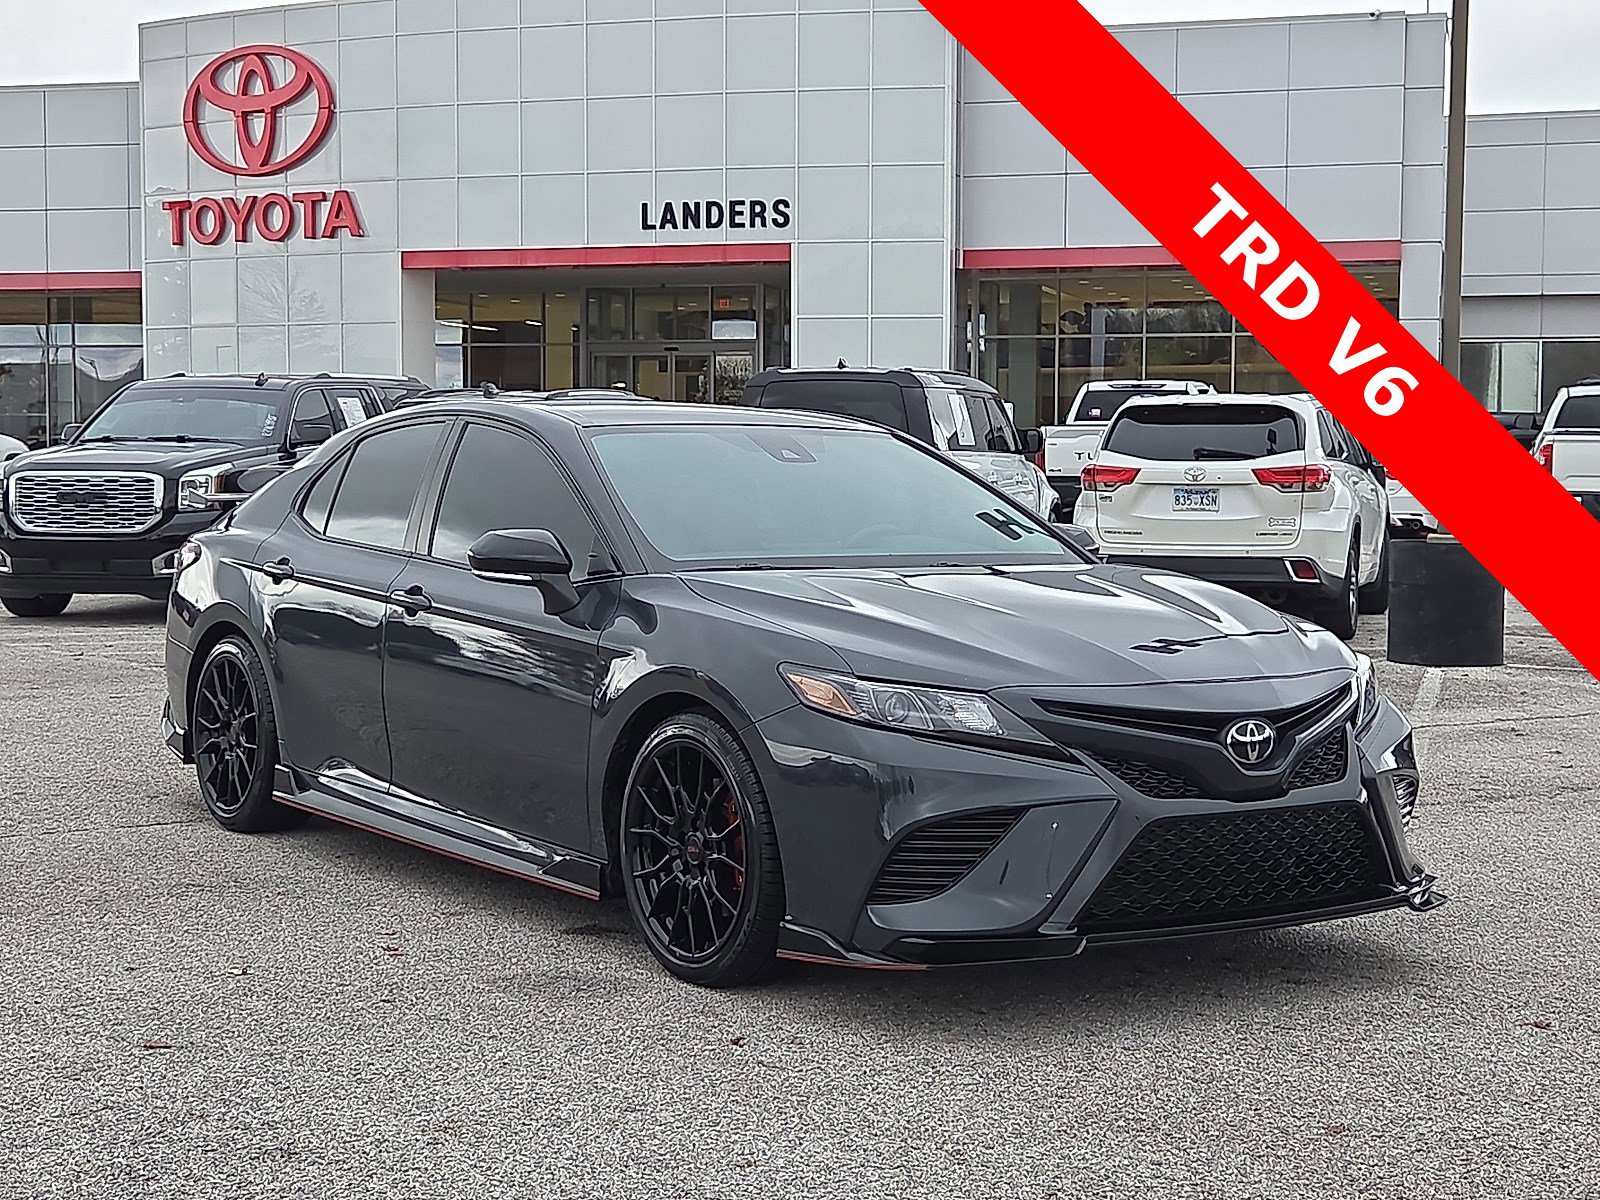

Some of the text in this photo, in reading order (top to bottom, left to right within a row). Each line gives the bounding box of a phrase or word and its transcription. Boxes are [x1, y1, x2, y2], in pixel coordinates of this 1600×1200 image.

[162, 190, 365, 246] TOYOTA
[641, 198, 791, 230] LANDERS
[1174, 494, 1218, 506] 835 XSN
